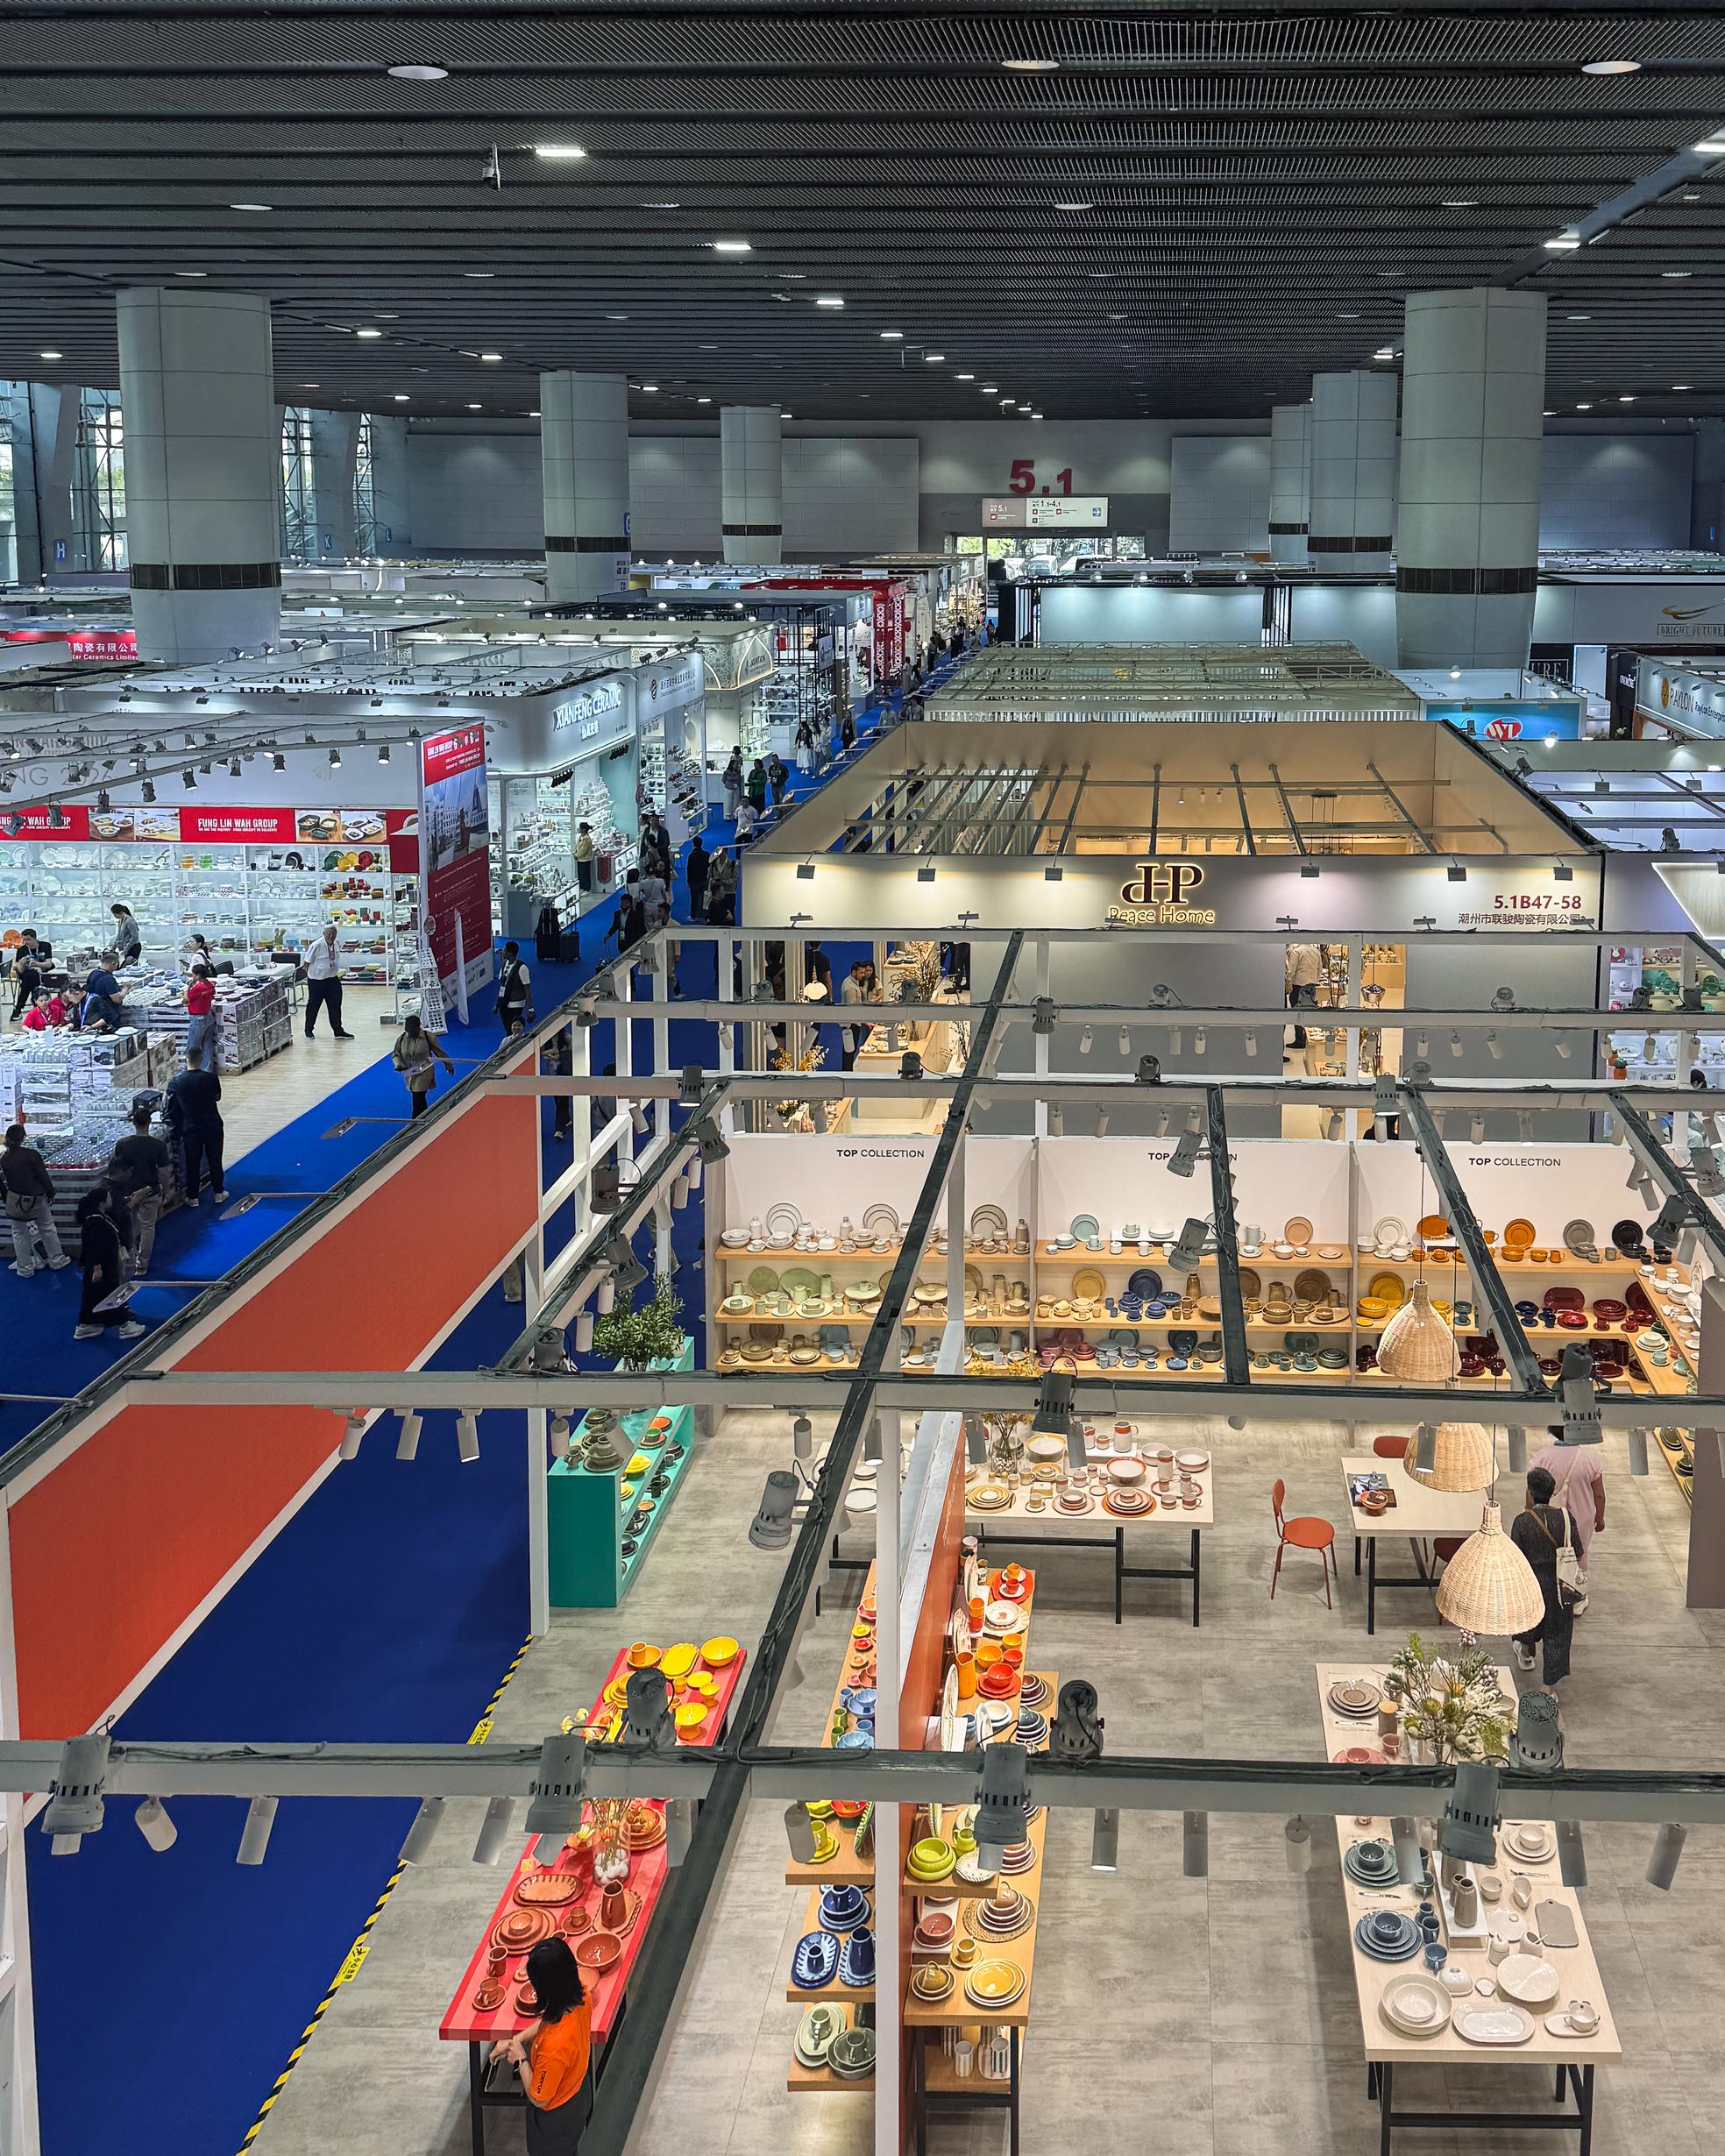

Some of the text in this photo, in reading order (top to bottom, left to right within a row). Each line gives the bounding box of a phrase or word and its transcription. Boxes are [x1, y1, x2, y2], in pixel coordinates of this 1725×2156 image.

[1009, 459, 1073, 496] 5.1
[56, 543, 65, 558] H
[555, 688, 621, 729] XIANFENG CERAMIC
[27, 816, 45, 826] WAH
[197, 818, 278, 828] FUNG LIN WAH GROUP
[1494, 895, 1582, 910] 5.1B47-58
[1109, 904, 1216, 924] Peace Home
[836, 1149, 925, 1158] TOP COLLECTION
[1494, 1158, 1561, 1167] COLLECTION
